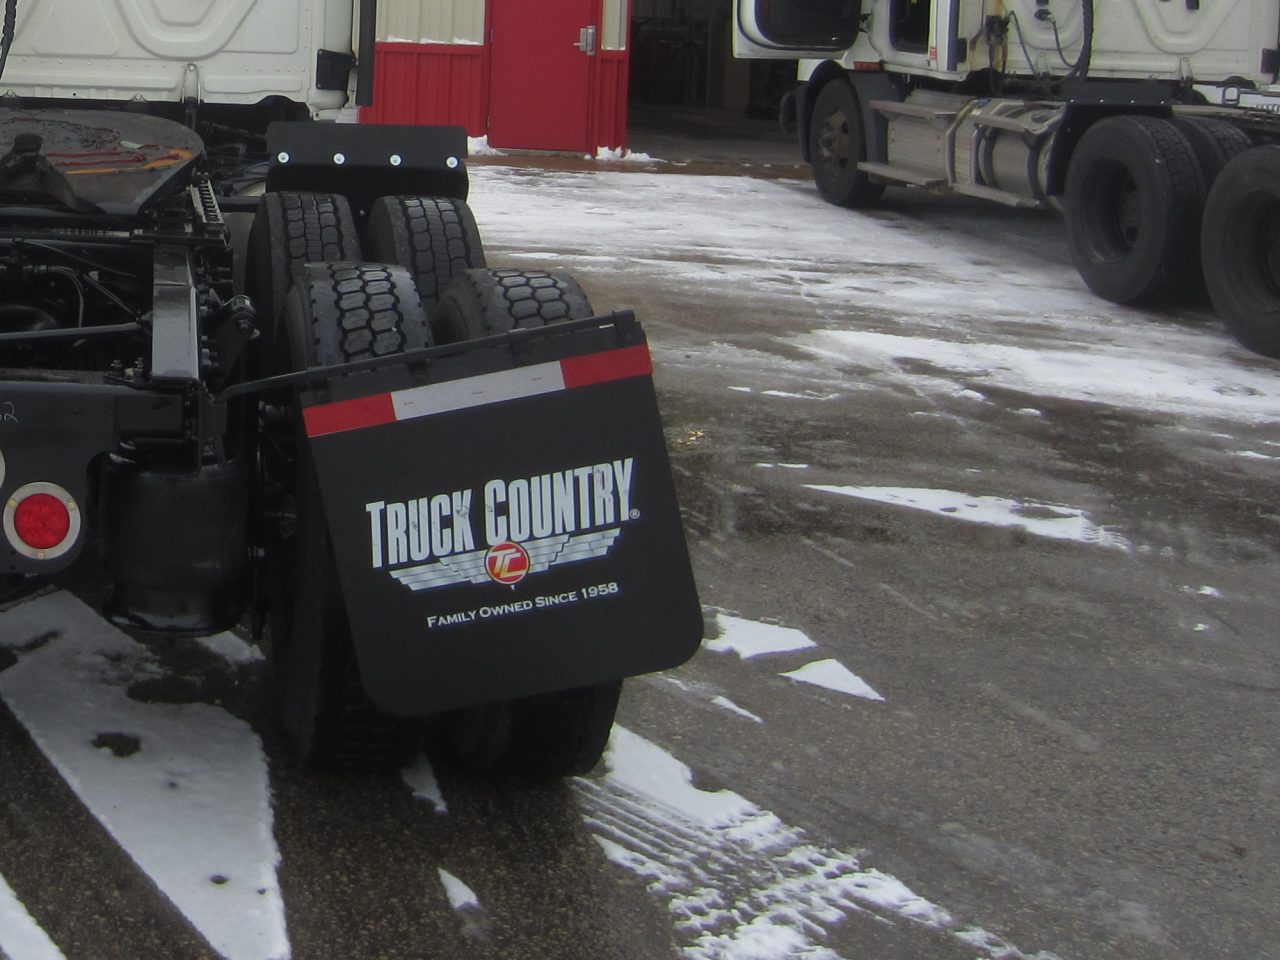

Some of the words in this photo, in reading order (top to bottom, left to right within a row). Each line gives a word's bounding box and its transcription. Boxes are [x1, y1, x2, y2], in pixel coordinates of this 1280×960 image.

[366, 489, 475, 569] TRUCK
[426, 609, 478, 628] FAMILY
[479, 599, 533, 618] OWNED
[534, 591, 579, 608] SINCE
[580, 581, 619, 599] 1958
